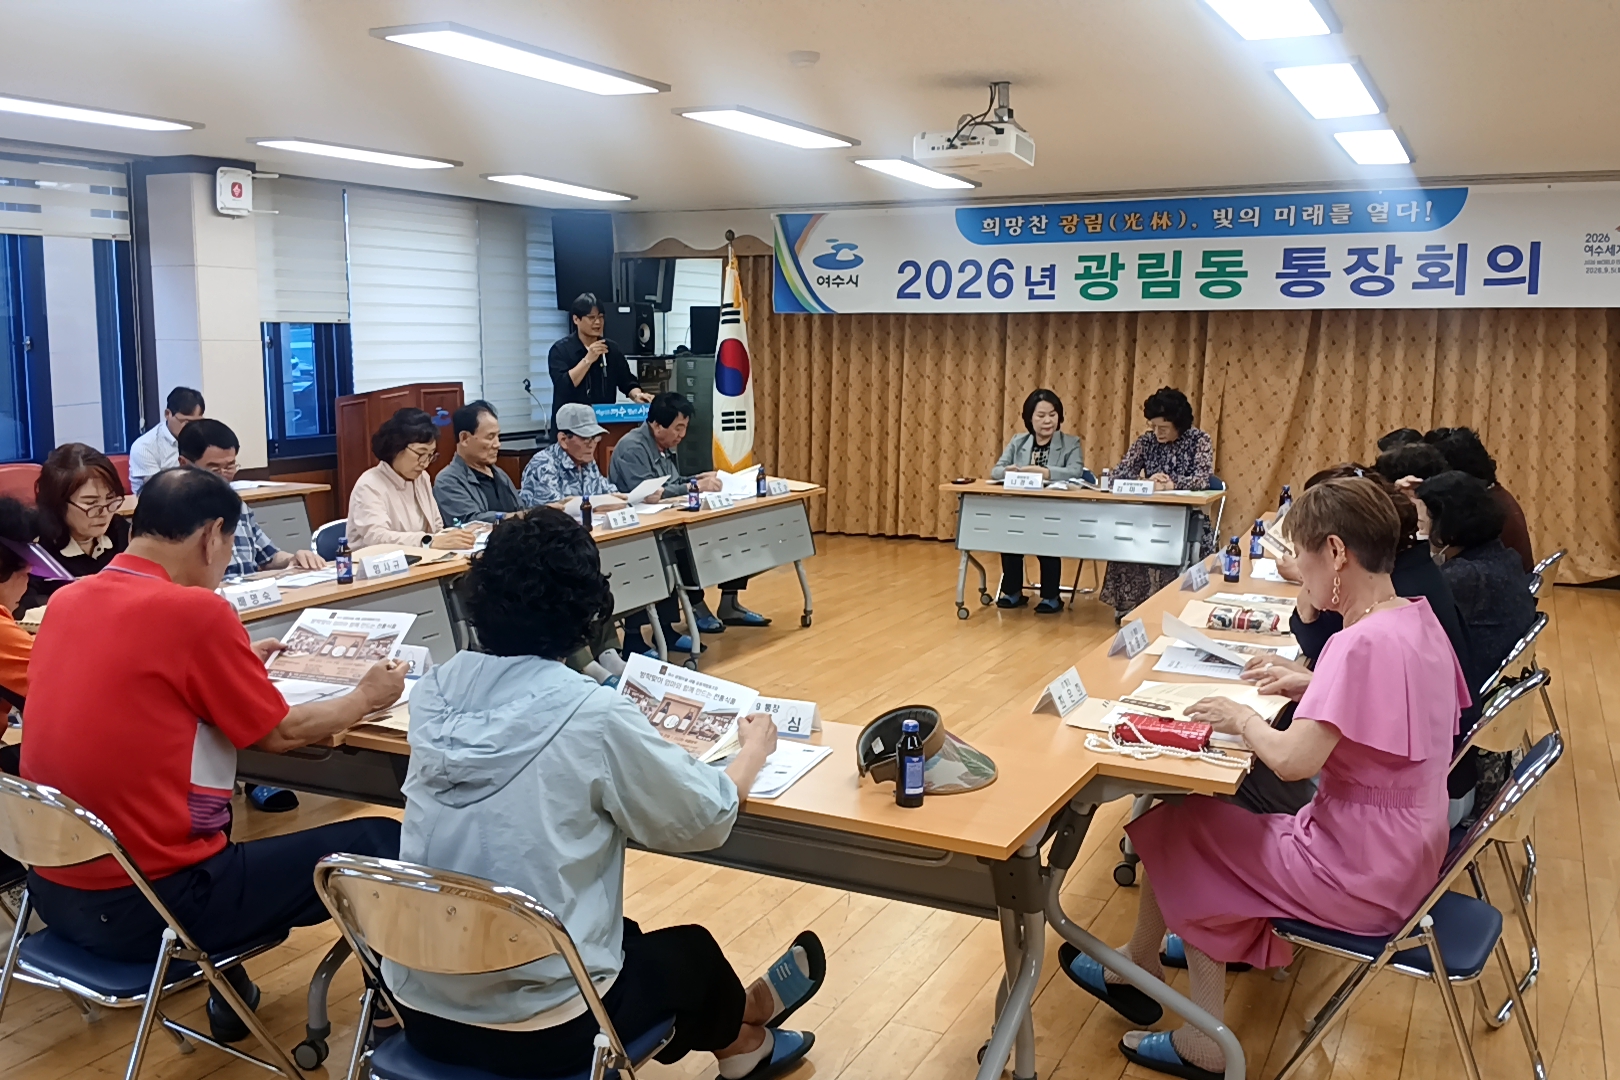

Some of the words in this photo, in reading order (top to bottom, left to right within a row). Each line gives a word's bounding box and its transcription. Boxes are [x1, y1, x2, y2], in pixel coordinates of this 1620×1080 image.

[981, 214, 1049, 236] 희망찬
[1274, 203, 1354, 227] 미래를
[1366, 200, 1433, 223] 열다!
[1585, 233, 1610, 243] 2026
[816, 273, 860, 288] 여수시
[896, 257, 1057, 301] 2026년
[1074, 249, 1249, 301] 광림동
[1275, 241, 1542, 298] 통장회의
